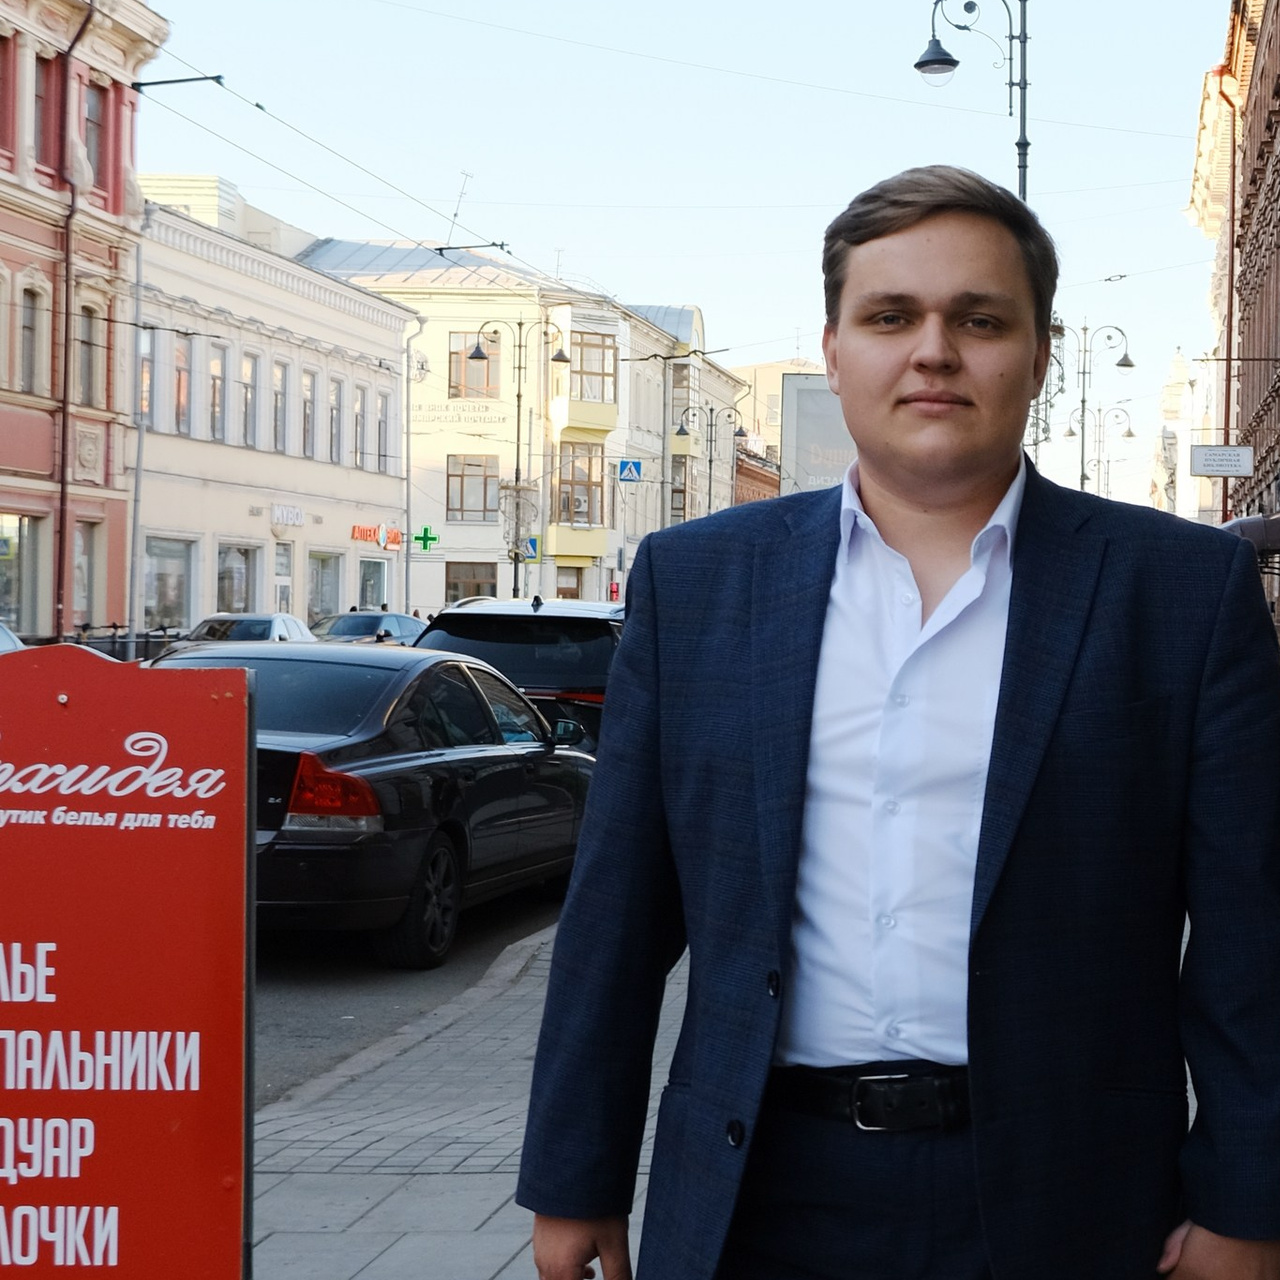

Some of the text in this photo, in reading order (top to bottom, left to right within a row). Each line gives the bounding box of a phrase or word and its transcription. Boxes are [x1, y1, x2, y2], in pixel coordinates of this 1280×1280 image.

[52, 806, 117, 826] белья
[119, 812, 162, 830] для
[167, 810, 216, 829] тебя
